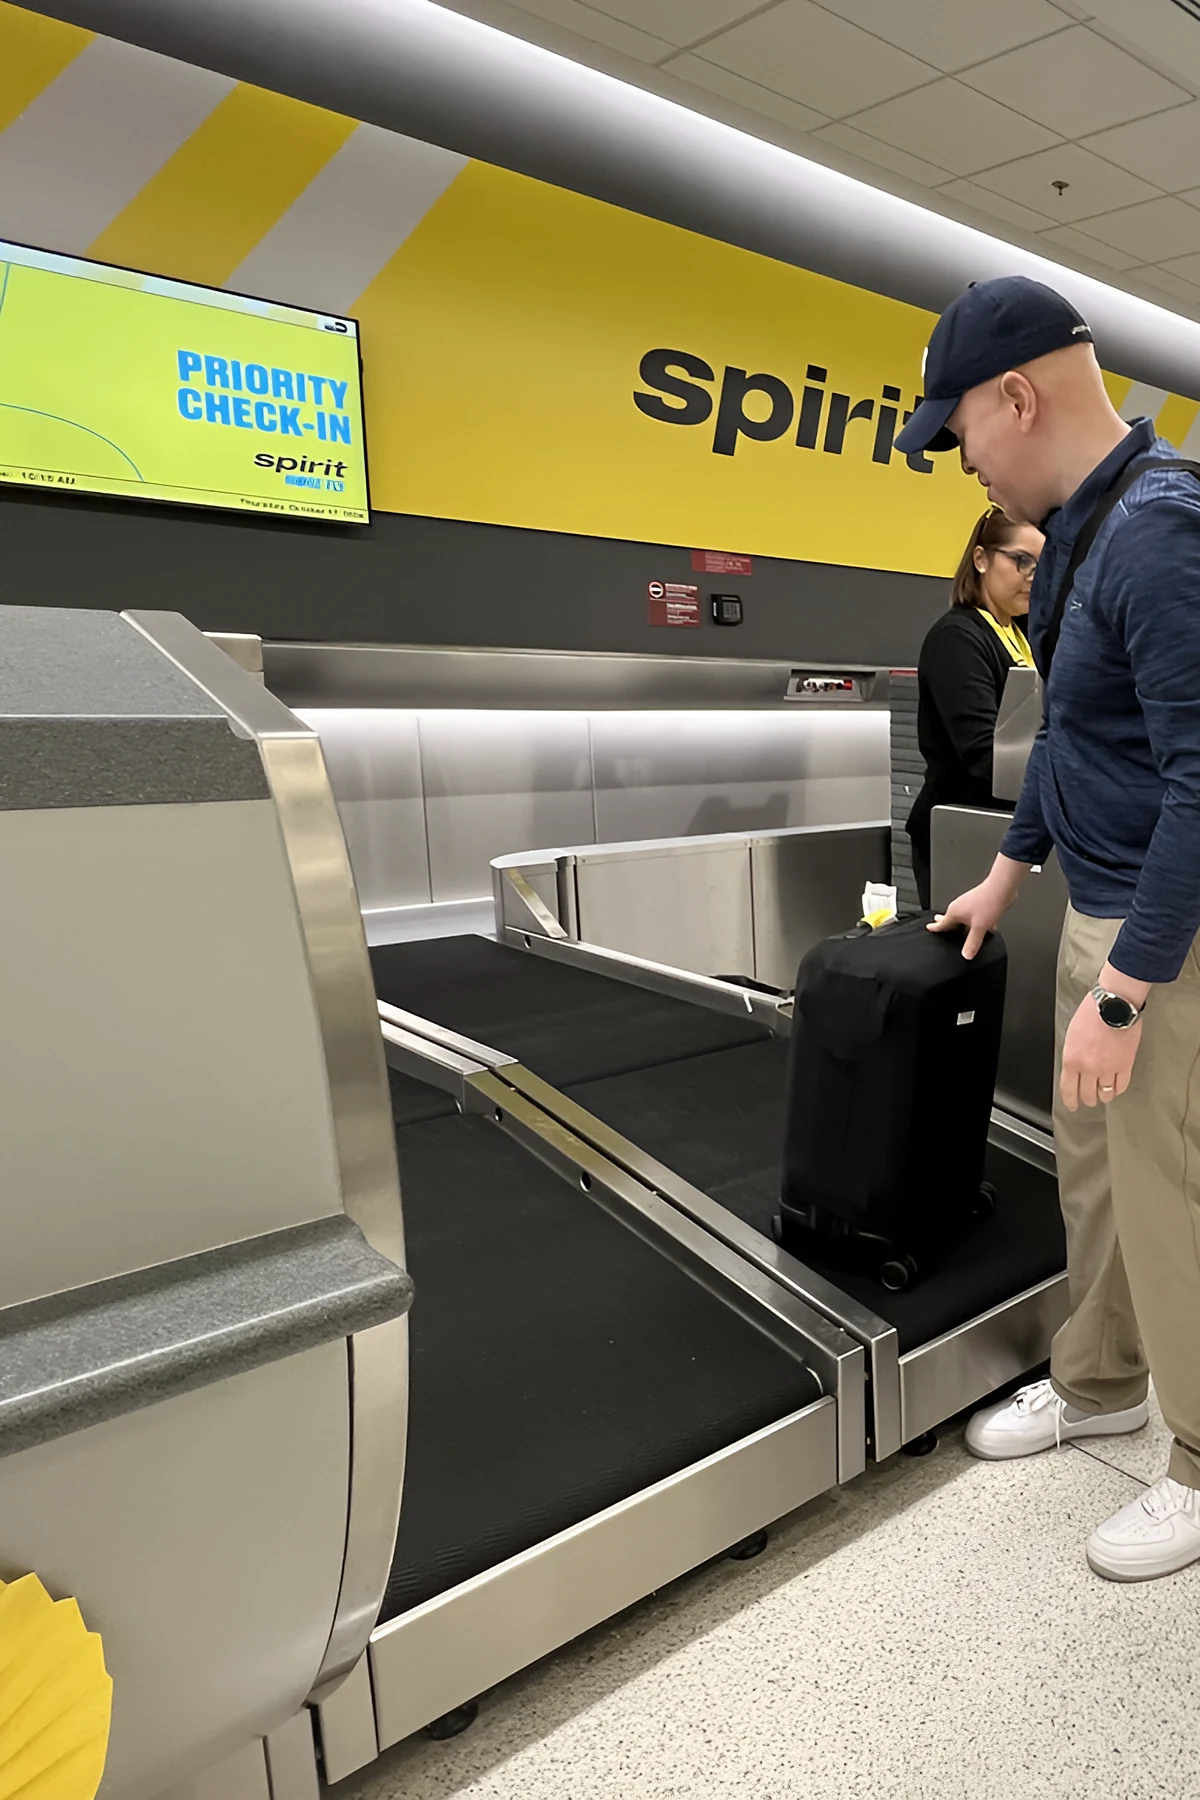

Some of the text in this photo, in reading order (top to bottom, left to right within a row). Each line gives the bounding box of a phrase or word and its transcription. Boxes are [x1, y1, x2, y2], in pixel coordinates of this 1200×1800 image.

[177, 350, 348, 409] PRIORITY
[177, 388, 351, 444] CHECK-IN
[253, 453, 347, 478] spirit
